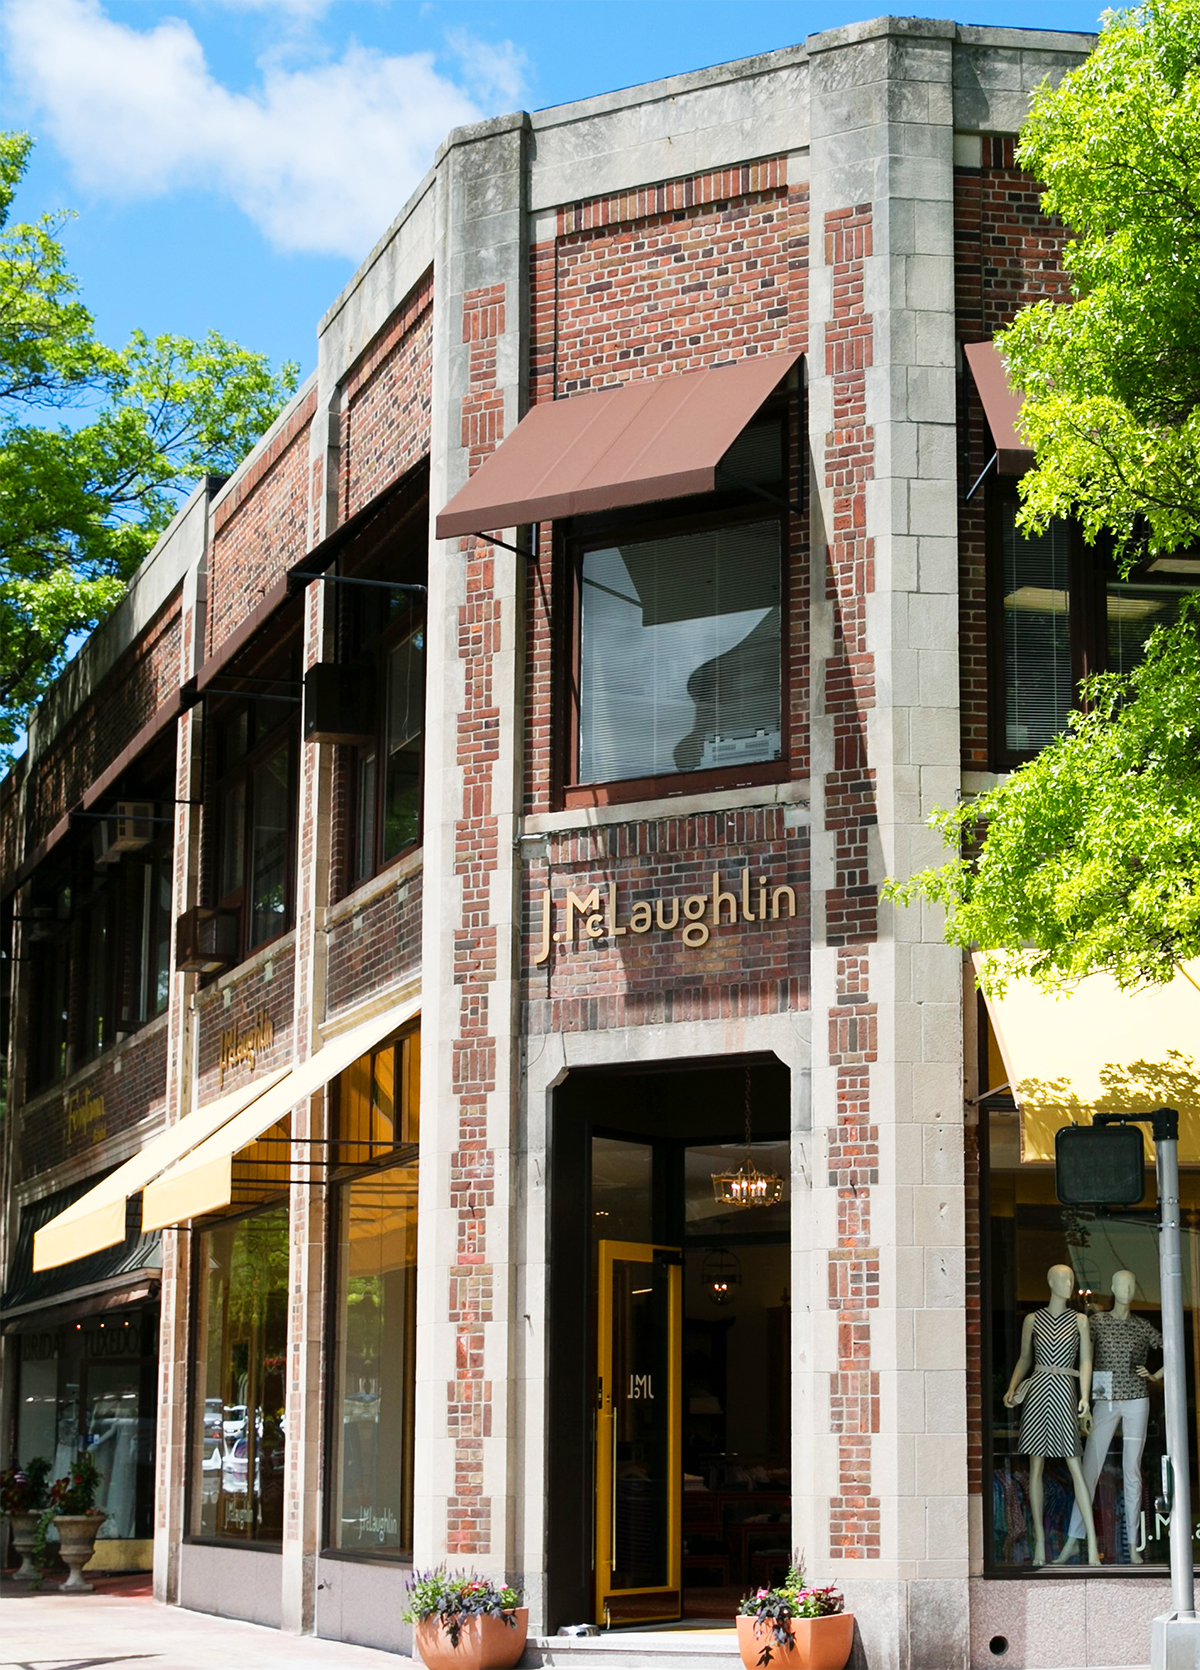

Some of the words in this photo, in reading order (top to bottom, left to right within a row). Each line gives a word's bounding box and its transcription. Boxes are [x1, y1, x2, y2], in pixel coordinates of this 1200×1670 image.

[534, 867, 796, 965] J.McLaughlin
[22, 1331, 69, 1361] BRIDAL
[83, 1327, 141, 1357] TUXEDO
